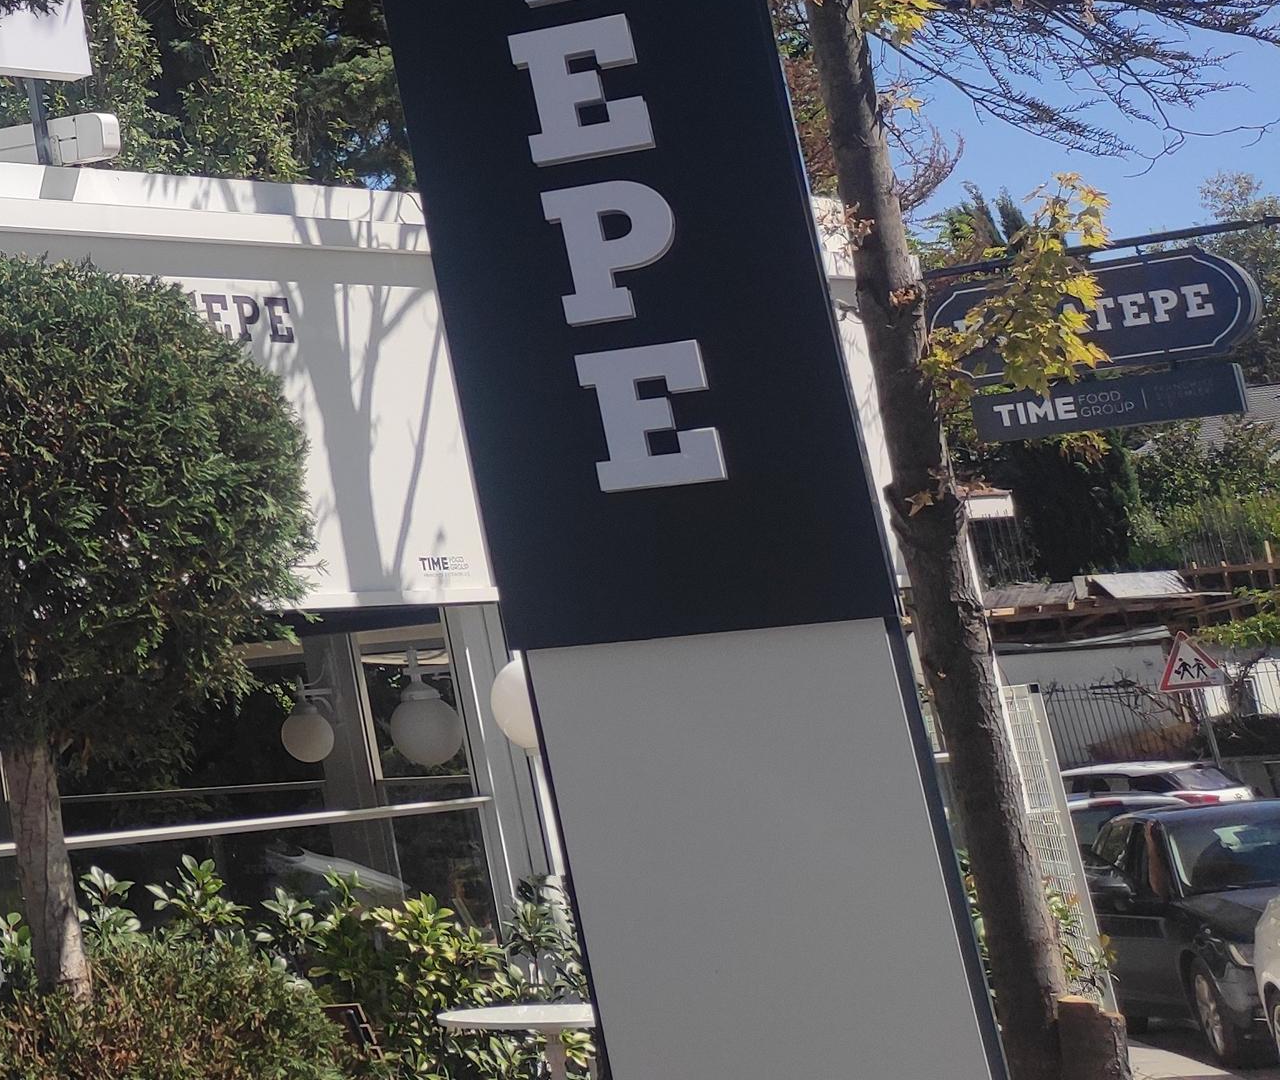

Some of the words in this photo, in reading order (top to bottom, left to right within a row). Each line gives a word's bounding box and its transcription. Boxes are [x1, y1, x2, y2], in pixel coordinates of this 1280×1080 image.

[1077, 390, 1121, 405] FOOD
[993, 395, 1079, 427] TIME
[1080, 401, 1136, 418] GROUP
[419, 556, 449, 571] TIME
